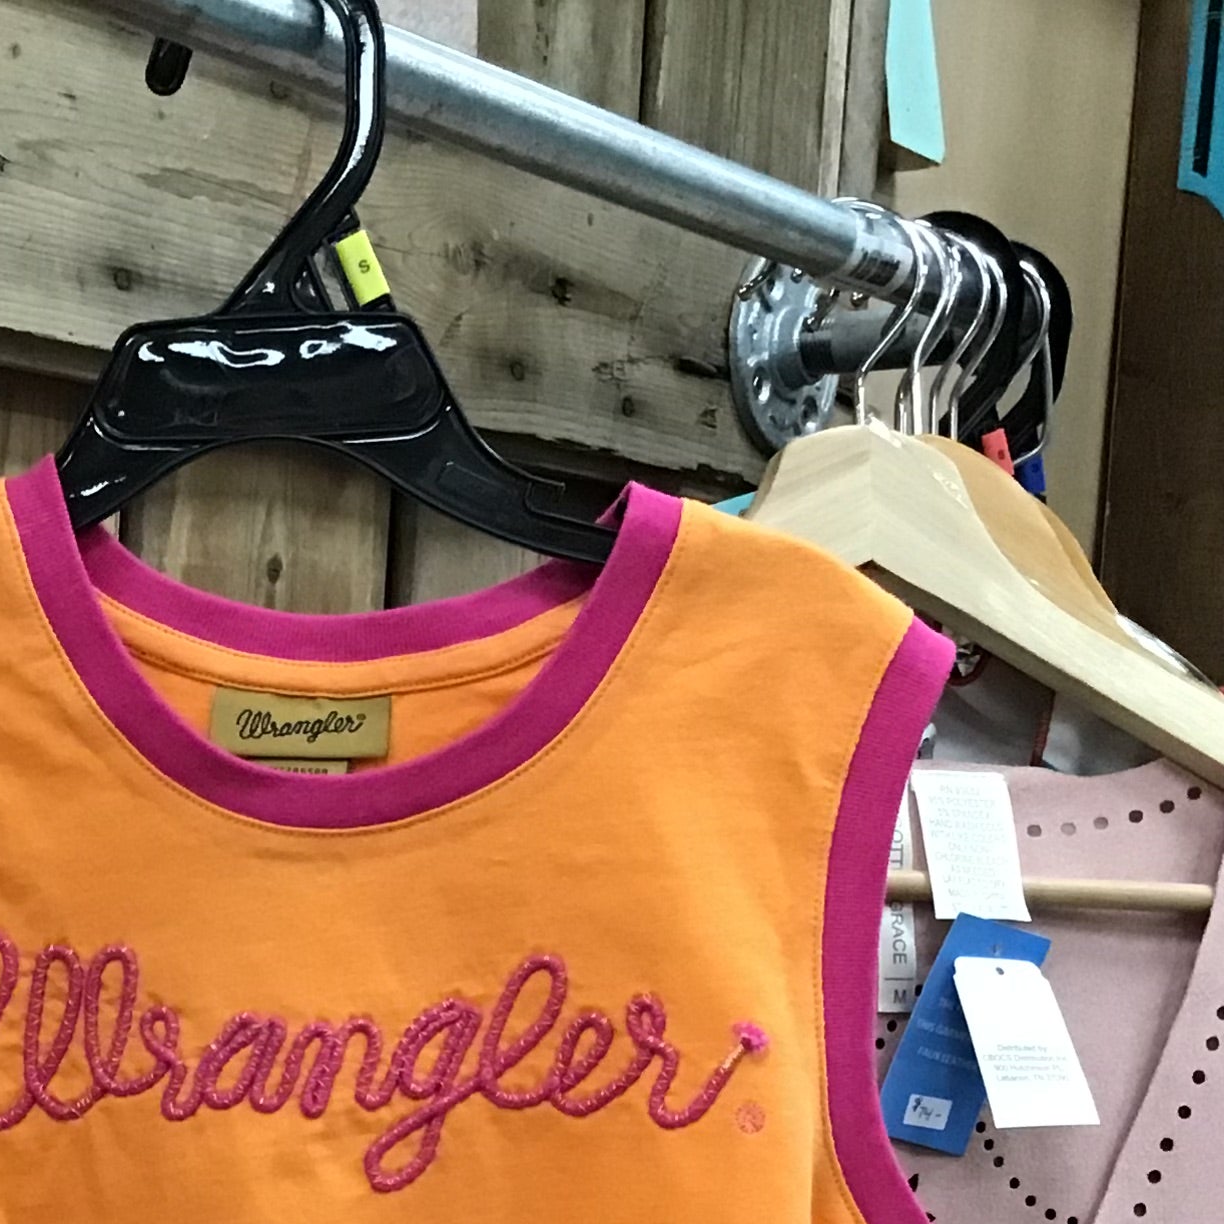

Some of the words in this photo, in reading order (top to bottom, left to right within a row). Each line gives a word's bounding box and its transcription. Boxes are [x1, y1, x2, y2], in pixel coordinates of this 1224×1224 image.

[358, 259, 371, 274] S
[236, 708, 364, 744] Wrangler
[893, 989, 907, 1004] M
